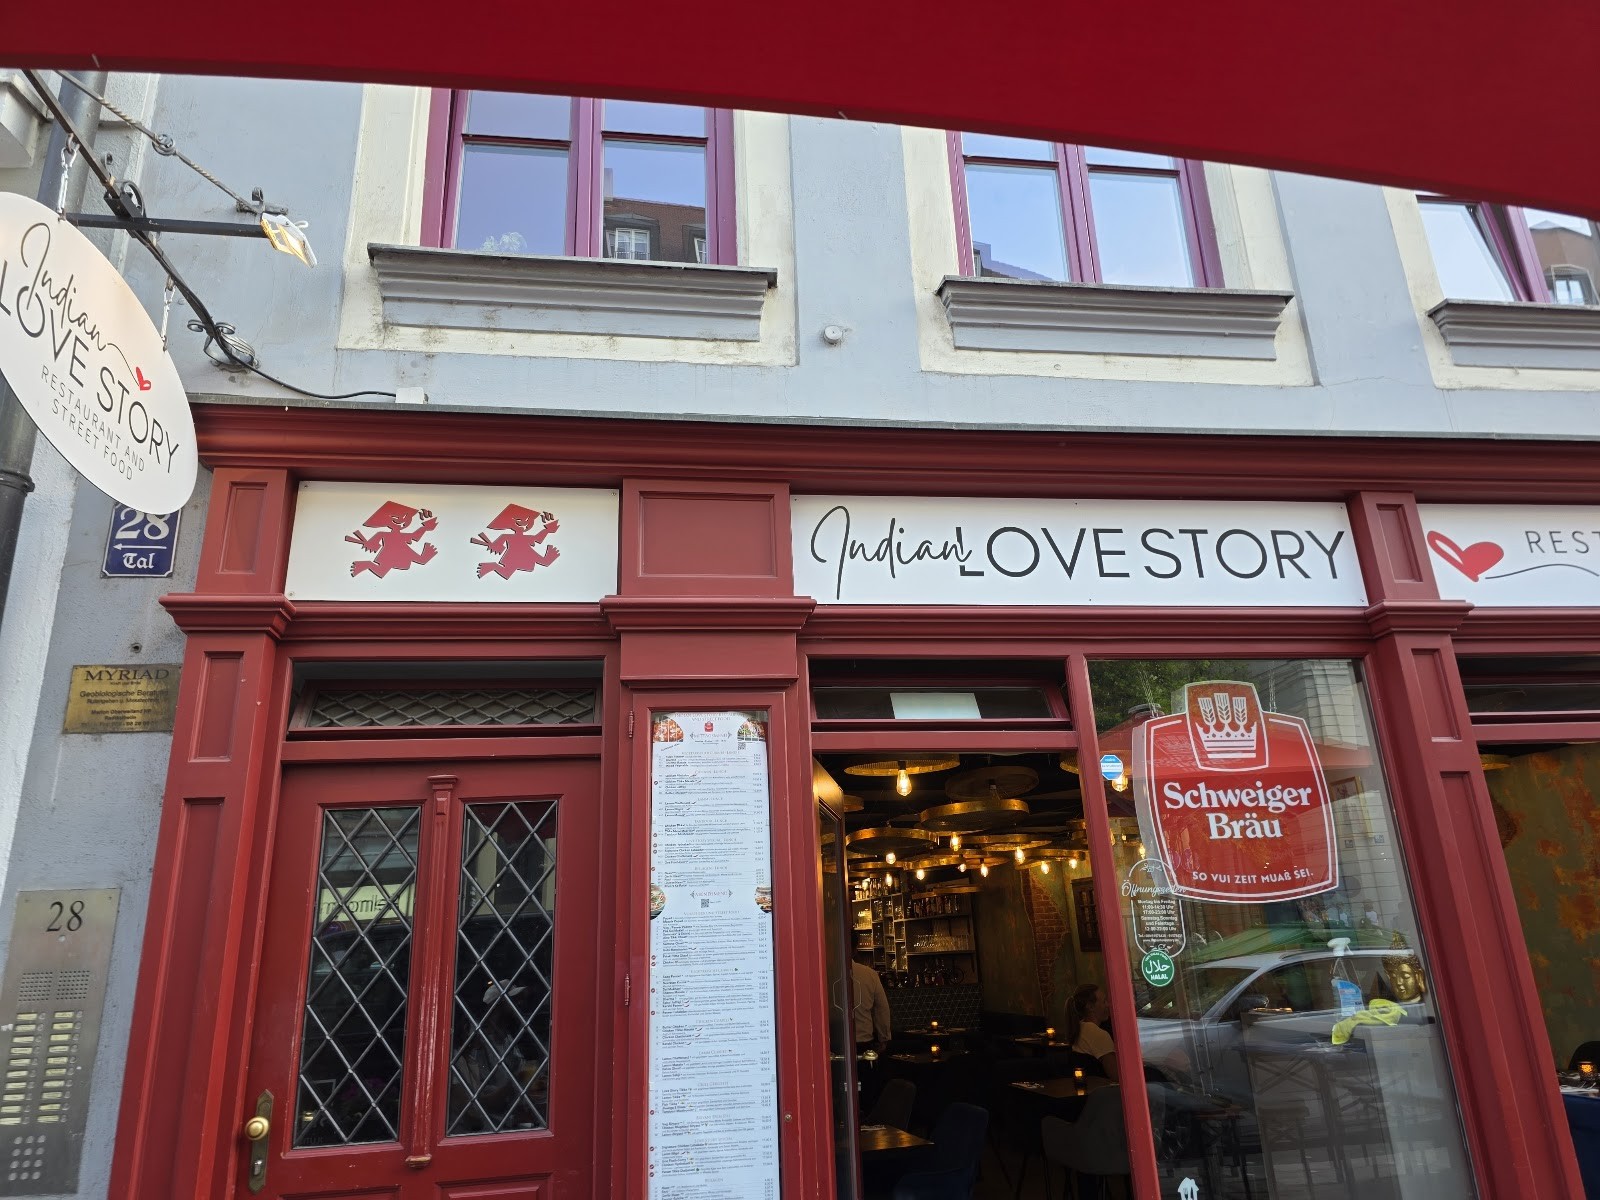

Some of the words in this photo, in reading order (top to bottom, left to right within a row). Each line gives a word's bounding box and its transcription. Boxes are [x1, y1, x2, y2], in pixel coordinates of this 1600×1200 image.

[20, 222, 107, 352] Indian
[0, 260, 90, 388] LOVE
[97, 366, 180, 474] STORY
[41, 364, 122, 450] RESTAURANT
[124, 444, 146, 473] AND
[51, 398, 99, 451] STREET
[103, 444, 133, 481] FOOD
[115, 507, 171, 540] 28
[122, 552, 156, 569] Tal
[810, 505, 972, 600] Indian
[956, 526, 1131, 580] LOVE
[1140, 527, 1345, 580] STORY
[86, 669, 169, 681] MYRIAD
[1163, 780, 1312, 813] Schweiger
[1206, 812, 1283, 840] Bräu
[1192, 871, 1208, 881] SO
[1210, 873, 1231, 883] VUI
[1234, 874, 1257, 884] ZEIT
[1294, 867, 1314, 879] SEI.
[46, 900, 85, 933] 28
[1145, 959, 1170, 974] حلال
[1150, 973, 1169, 981] HALAL
